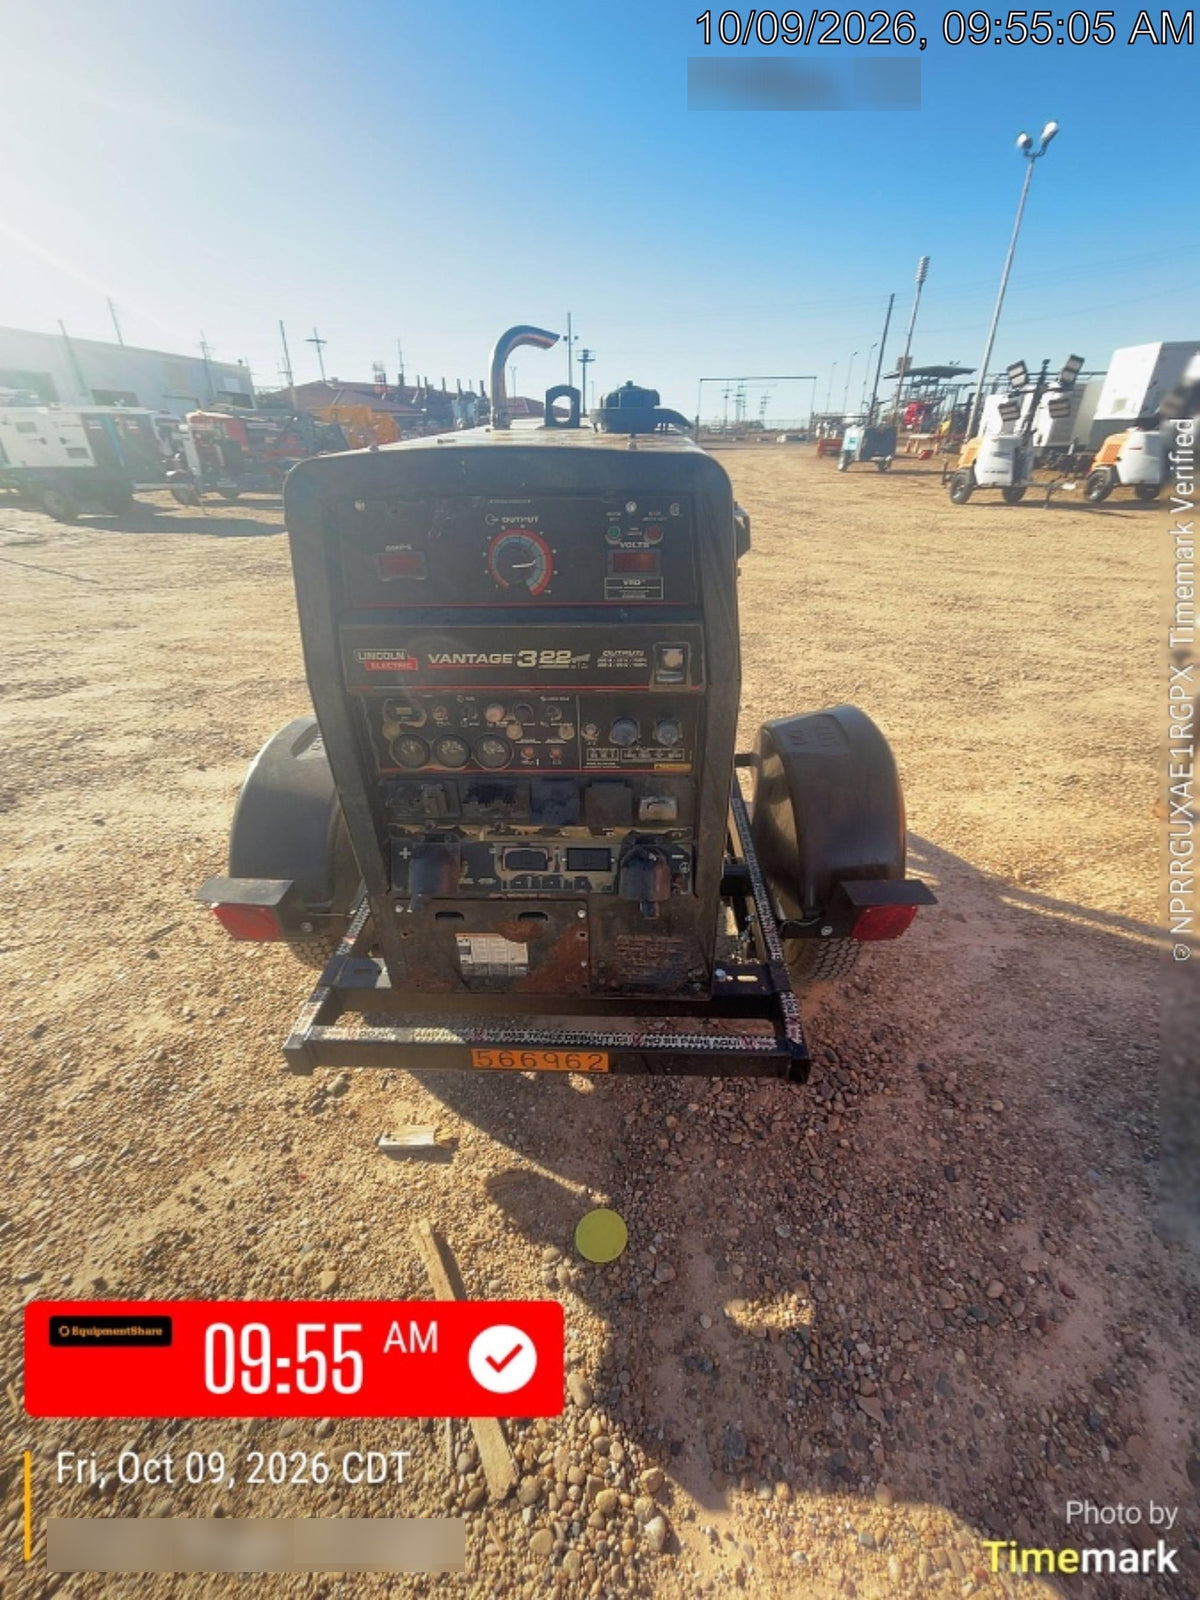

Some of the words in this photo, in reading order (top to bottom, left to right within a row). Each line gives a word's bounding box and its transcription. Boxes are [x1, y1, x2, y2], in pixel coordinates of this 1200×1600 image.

[358, 651, 406, 661] LINCOLN
[427, 653, 513, 664] VANTAGE
[516, 650, 572, 668] 322
[370, 662, 414, 670] ELECTRIC
[476, 1050, 604, 1072] 566962
